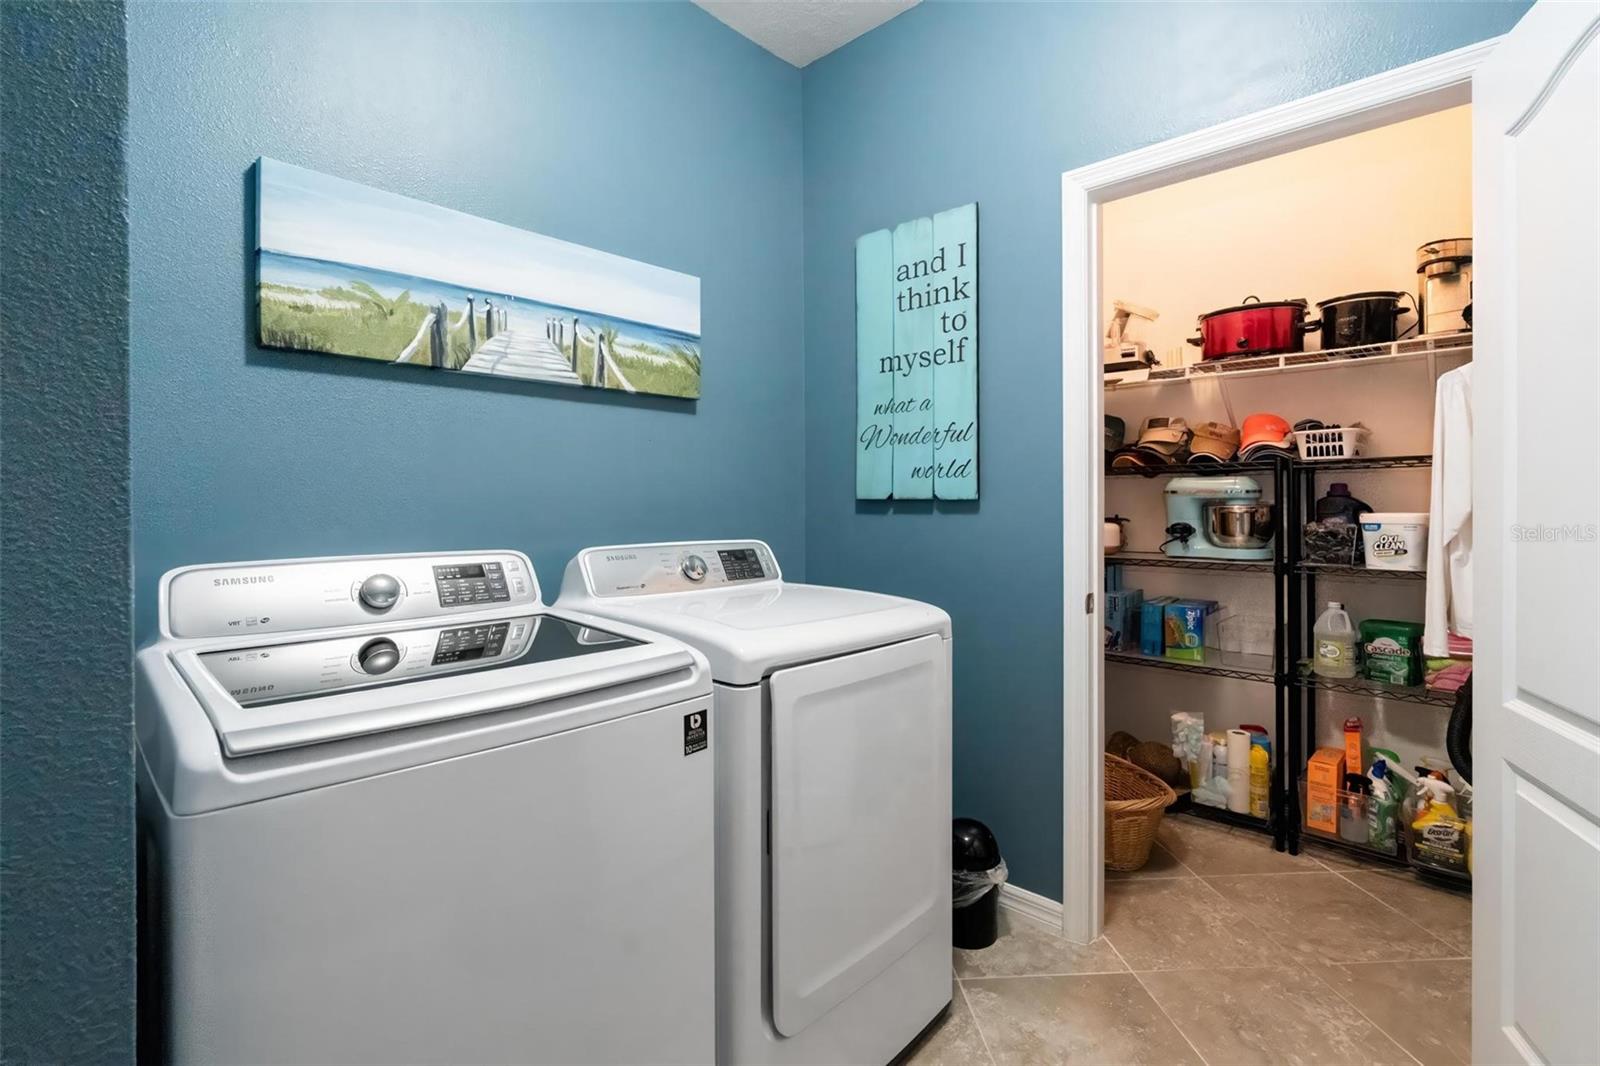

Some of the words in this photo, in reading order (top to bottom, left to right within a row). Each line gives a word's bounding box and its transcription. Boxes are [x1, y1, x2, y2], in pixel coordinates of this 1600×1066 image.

[896, 247, 946, 282] and
[957, 242, 966, 268] I
[896, 276, 971, 312] think
[940, 311, 967, 334] to
[879, 336, 969, 377] myself
[874, 398, 916, 415] what
[919, 398, 933, 411] a
[860, 421, 974, 450] Wonderful
[911, 458, 971, 479] world
[1373, 541, 1405, 551] CLEAN
[1380, 534, 1399, 544] OXI
[213, 575, 274, 587] SAMSUNG
[1364, 643, 1411, 657] Cascade
